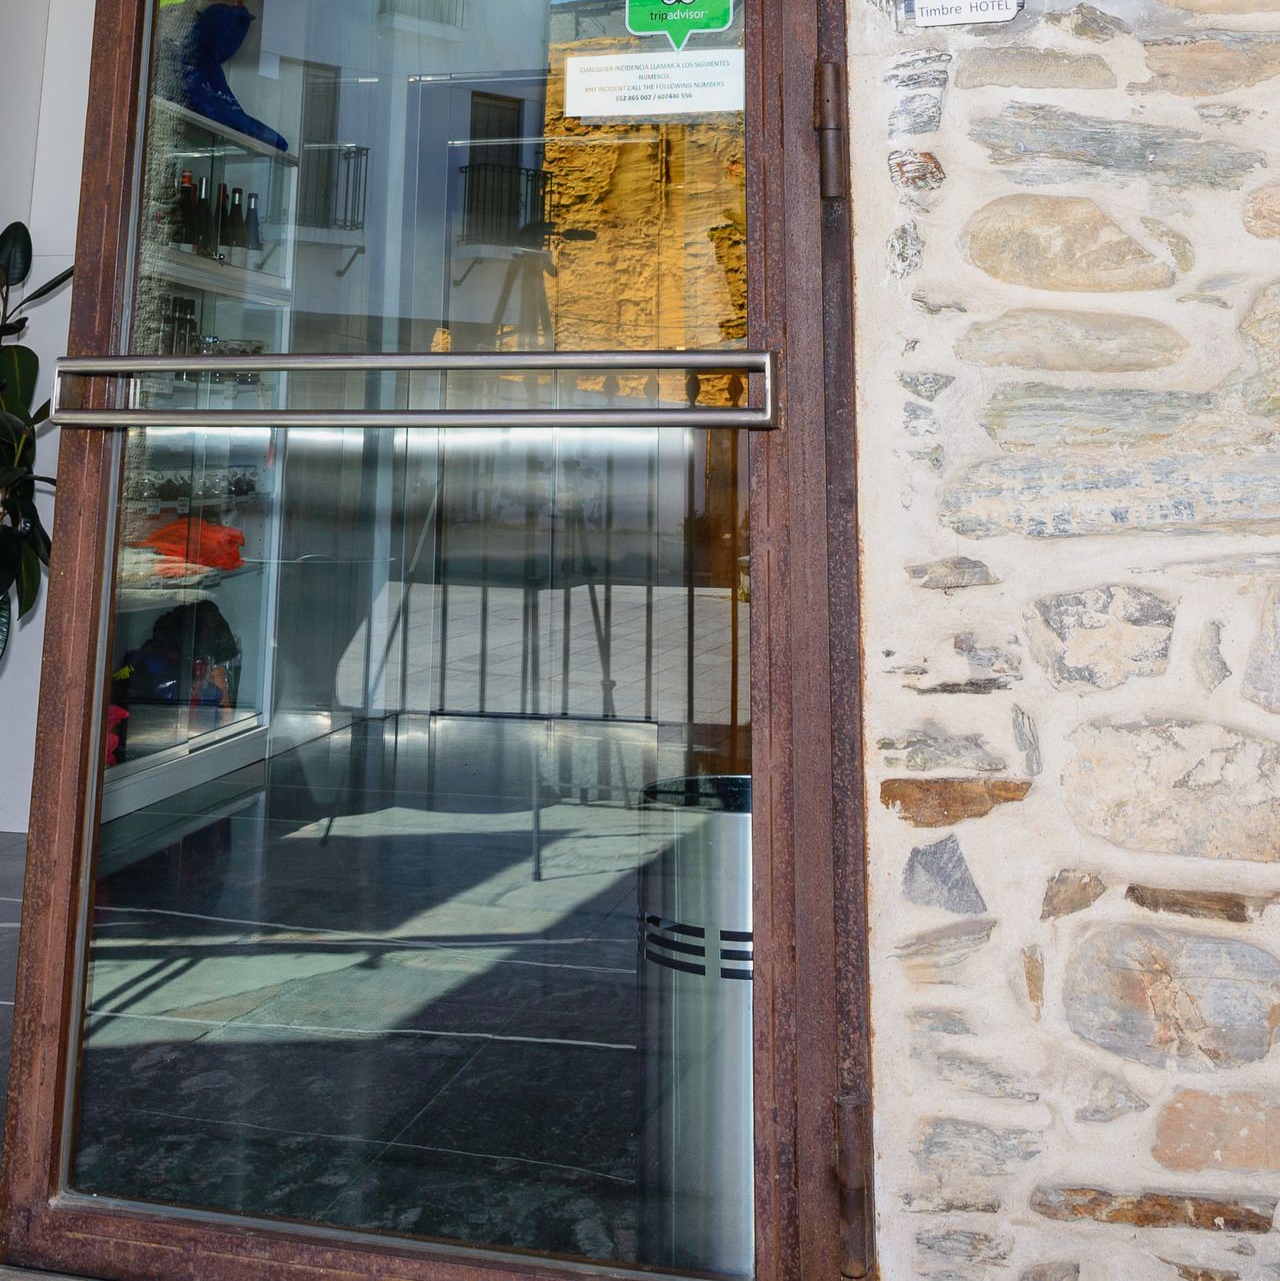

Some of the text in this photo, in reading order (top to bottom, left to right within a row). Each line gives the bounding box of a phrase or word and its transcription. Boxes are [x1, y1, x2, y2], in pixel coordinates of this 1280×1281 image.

[650, 9, 705, 22] tripadvisor
[918, 0, 1012, 18] Timbre HOTEL
[650, 62, 674, 70] LLAMAR
